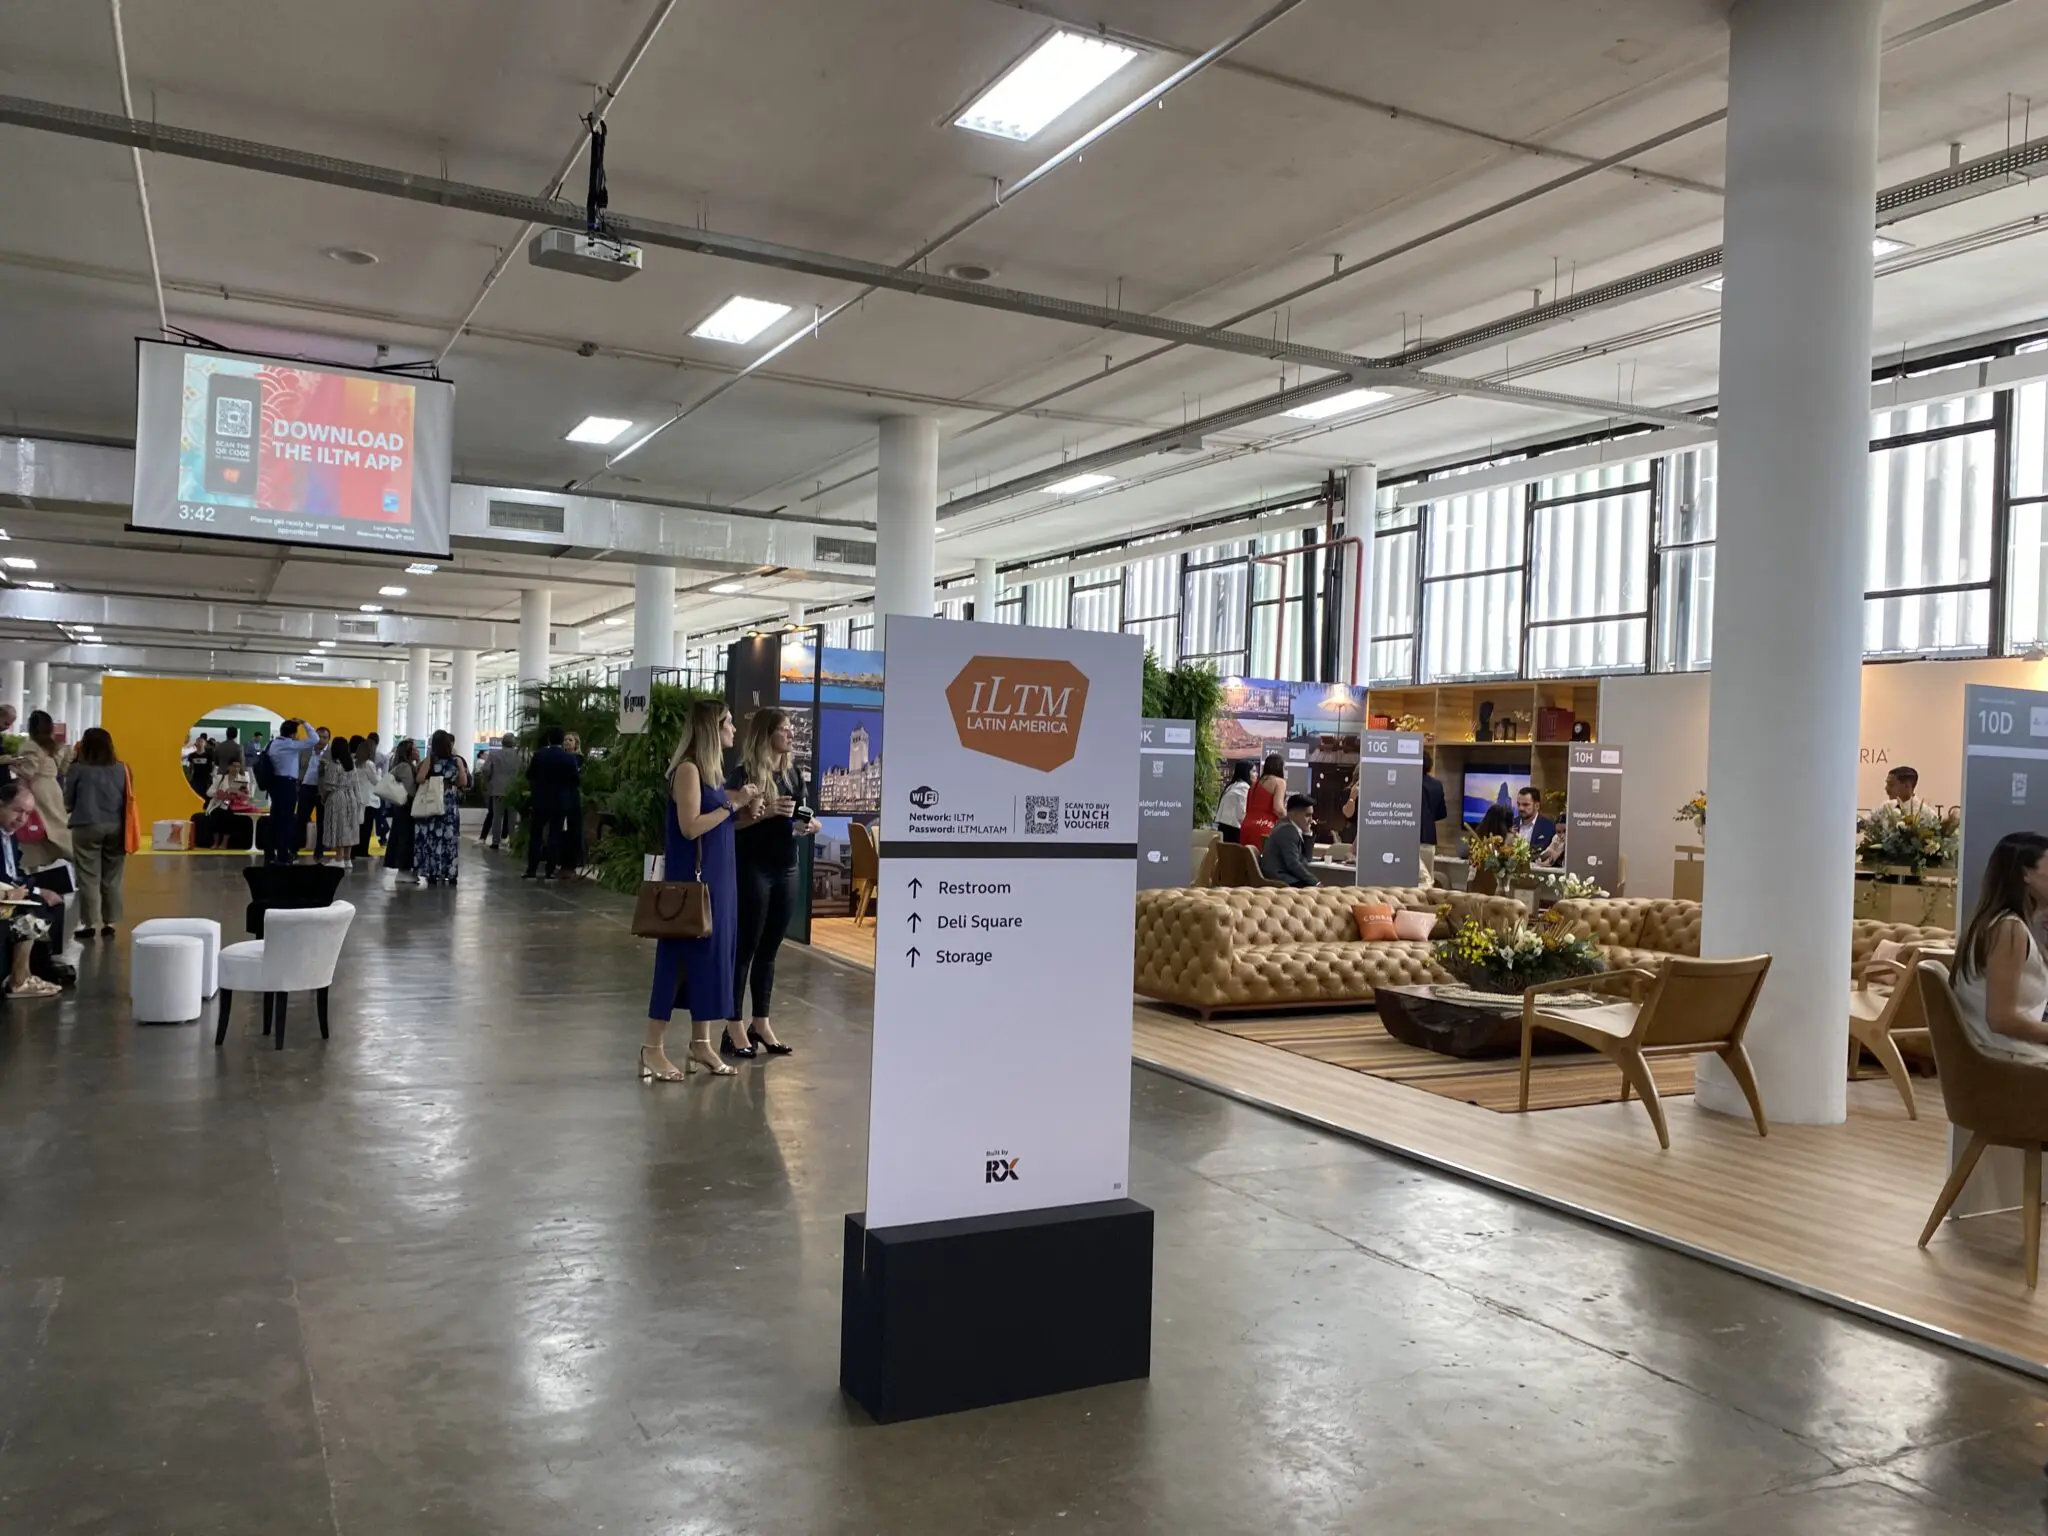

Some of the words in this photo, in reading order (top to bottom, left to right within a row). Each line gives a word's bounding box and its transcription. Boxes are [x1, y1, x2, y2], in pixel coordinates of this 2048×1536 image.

[273, 418, 404, 451] DOWNLOAD
[215, 447, 227, 455] QR
[228, 448, 250, 457] CODE
[272, 441, 312, 462] THE
[317, 446, 360, 468] ILTM
[364, 452, 402, 472] APP
[179, 504, 215, 522] 3:42
[967, 717, 1006, 731] LATIN
[1009, 719, 1069, 733] AMERICA
[1978, 710, 2013, 735] 10D
[1367, 741, 1388, 753] 10G
[1575, 752, 1593, 763] 10H
[1859, 748, 1888, 764] RIA
[1065, 802, 1083, 810] SCAN
[1085, 802, 1094, 810] TO
[1139, 799, 1159, 808] aldorf
[1159, 800, 1182, 808] Astoria
[909, 813, 951, 822] Network:
[954, 813, 974, 822] ILTM
[1064, 810, 1109, 820] LUNCH
[1143, 809, 1170, 817] Orlando
[909, 825, 955, 834] Password:
[957, 825, 1007, 834] ILTMLATAM
[1064, 820, 1110, 830] VOUCHER
[938, 881, 1011, 895] Restroom
[937, 915, 967, 929] Deli
[971, 914, 1023, 931] Square
[936, 950, 993, 965] Storage
[986, 1158, 1020, 1183] RX
